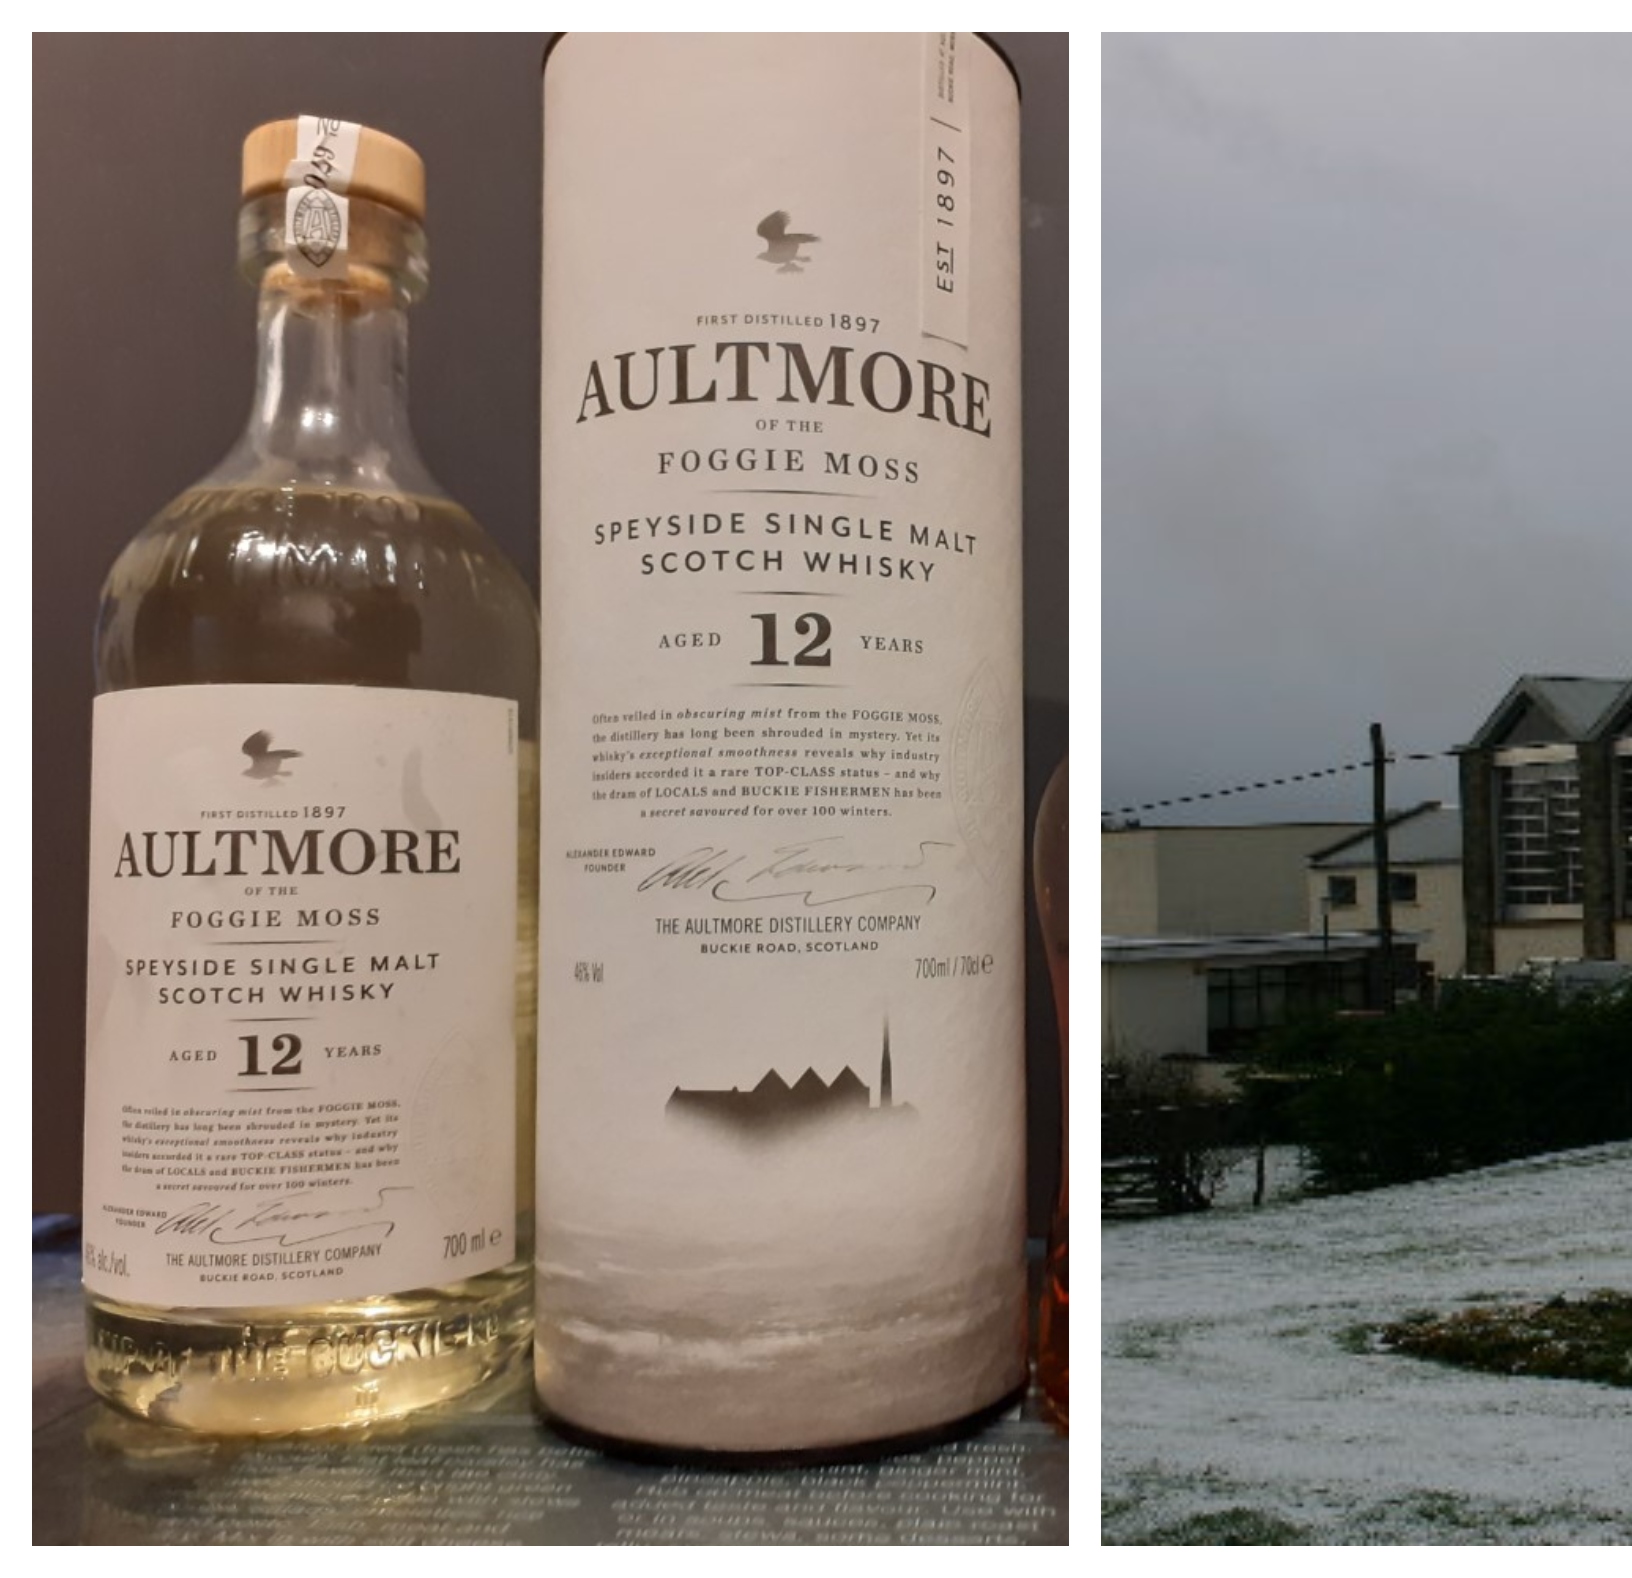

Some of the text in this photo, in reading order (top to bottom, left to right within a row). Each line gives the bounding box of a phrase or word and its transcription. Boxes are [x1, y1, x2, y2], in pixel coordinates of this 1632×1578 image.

[936, 147, 956, 293] EST 1897
[696, 313, 881, 334] FIRST DISTILLED 1897
[575, 341, 993, 439] AULTMORE
[755, 419, 824, 433] OF THE
[657, 448, 920, 484] FOGGIE MOSS
[594, 512, 977, 556] SPEYSIDE SINGLE MALT
[641, 549, 935, 582] SCOTCH WHISKY
[658, 612, 924, 667] AGED 12 YEARS
[592, 713, 620, 725] Often
[622, 710, 656, 722] veiled
[660, 710, 672, 720] in
[676, 708, 746, 721] obscuring
[750, 707, 783, 719] mist
[787, 708, 821, 719] from
[826, 709, 847, 719] the
[852, 709, 904, 722] FOGGIE
[592, 728, 940, 744] the distillery has long been shrouded in mystery. Yet its
[639, 747, 713, 761] exceptional
[717, 747, 798, 757] smoothness
[804, 748, 854, 758] reveals
[860, 748, 886, 761] why
[891, 749, 941, 763] industry
[592, 766, 941, 782] insiders accorded it a rare TOP-CLASS status and why
[592, 785, 942, 801] the dram of LOCALS and BUCKIE FISHERMEN has been
[201, 806, 347, 819] FIRST DISTILLED 1897
[640, 805, 893, 818] a secret savoured for over 100 winters.
[114, 828, 461, 878] AULTMORE
[566, 847, 656, 859] ALEXANDER EDWARD
[584, 863, 626, 873] FOUNDER
[244, 886, 298, 897] OF THE
[171, 907, 381, 929] FOGGIE MOSS
[655, 915, 922, 935] THE AULTMORE DISTILLERY COMPANY
[700, 941, 879, 954] BUCKIE ROAD, SCOTLAND
[126, 953, 440, 976] SPEYSIDE SINGLE MALT
[915, 957, 950, 979] 700ml
[960, 955, 979, 977] 70cl
[158, 983, 396, 1005] SCOTCH WHISKY
[169, 1033, 382, 1076] AGED 12 YEARS
[266, 1106, 293, 1115] from
[297, 1105, 314, 1114] the
[318, 1102, 364, 1113] FOGGIE
[218, 1123, 241, 1131] been
[167, 1162, 351, 1176] LOCALS and BUCKIE FISHERMEN
[443, 1232, 467, 1259] 700
[471, 1227, 486, 1253] ml
[166, 1244, 382, 1268] THE AULTMORE DISTILLERY COMPANY
[200, 1273, 238, 1283] BUCKIE
[281, 1267, 343, 1280] SCOTLAND
